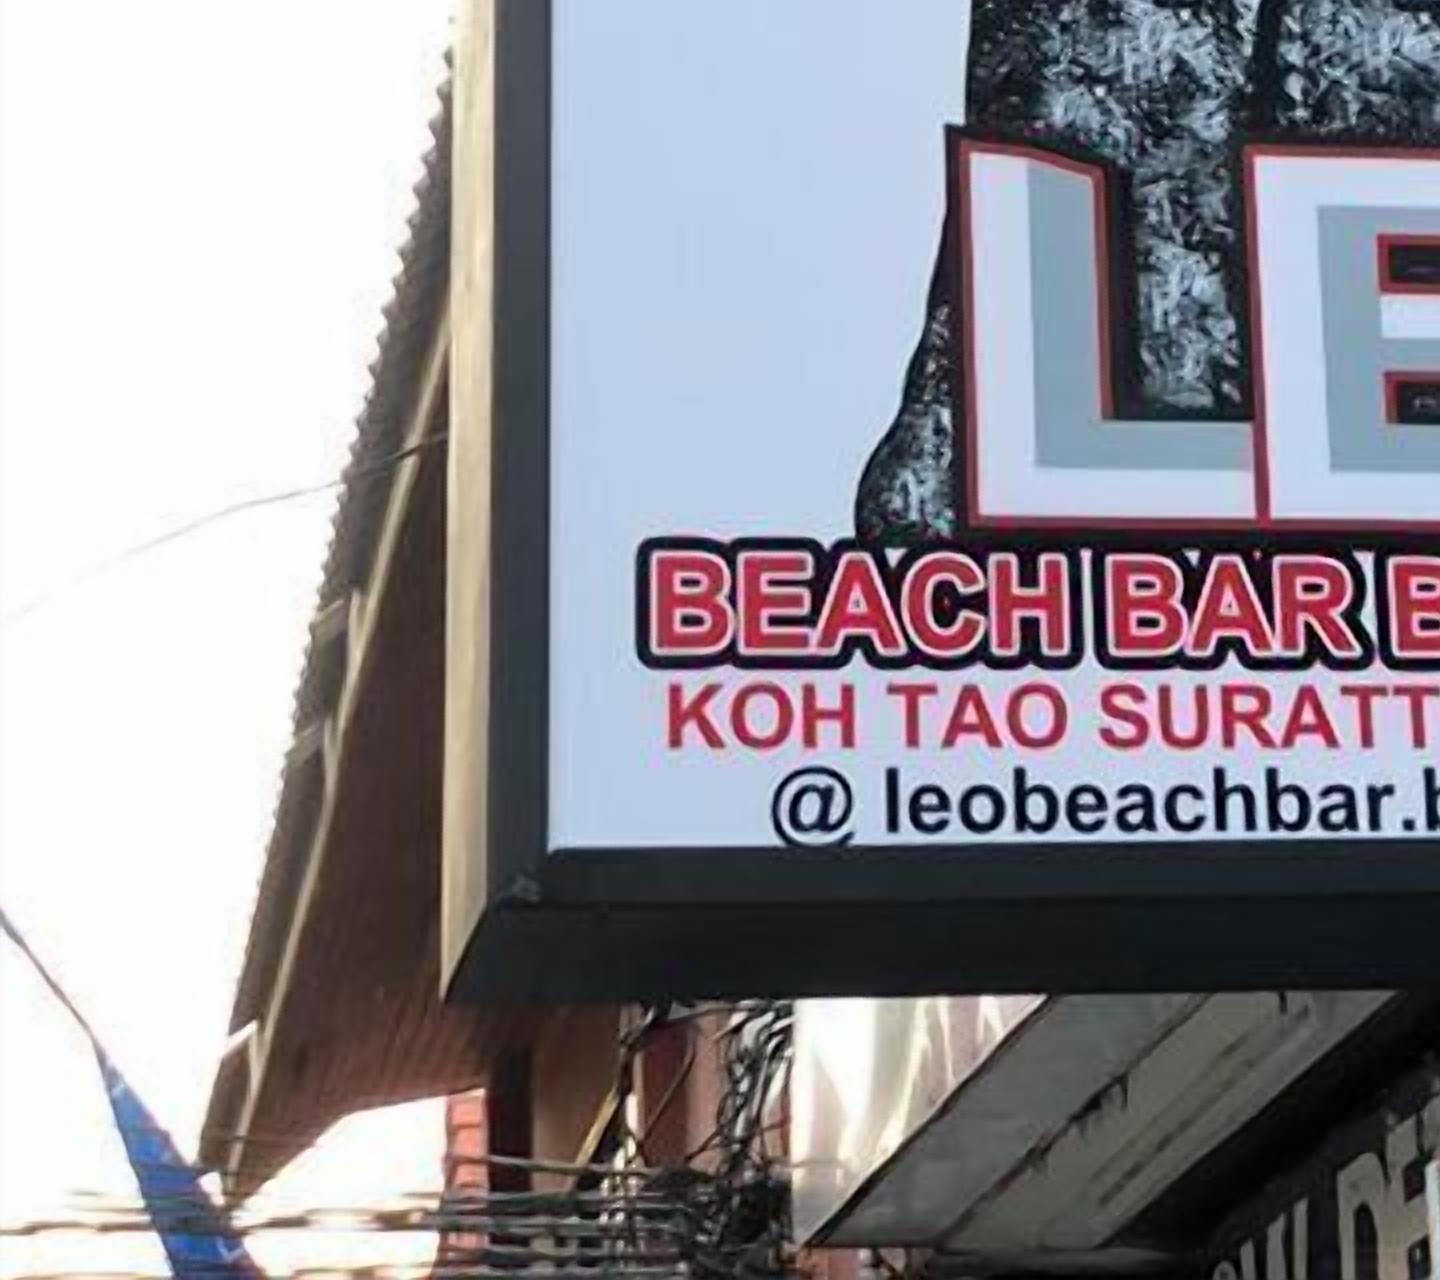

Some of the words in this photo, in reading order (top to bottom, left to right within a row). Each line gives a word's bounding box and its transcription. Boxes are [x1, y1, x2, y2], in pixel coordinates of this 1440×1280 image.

[638, 538, 1088, 669] BEACH
[1100, 548, 1368, 670] BAR
[667, 683, 857, 749] KOH
[886, 683, 1069, 749] TAO
[770, 765, 856, 846] @
